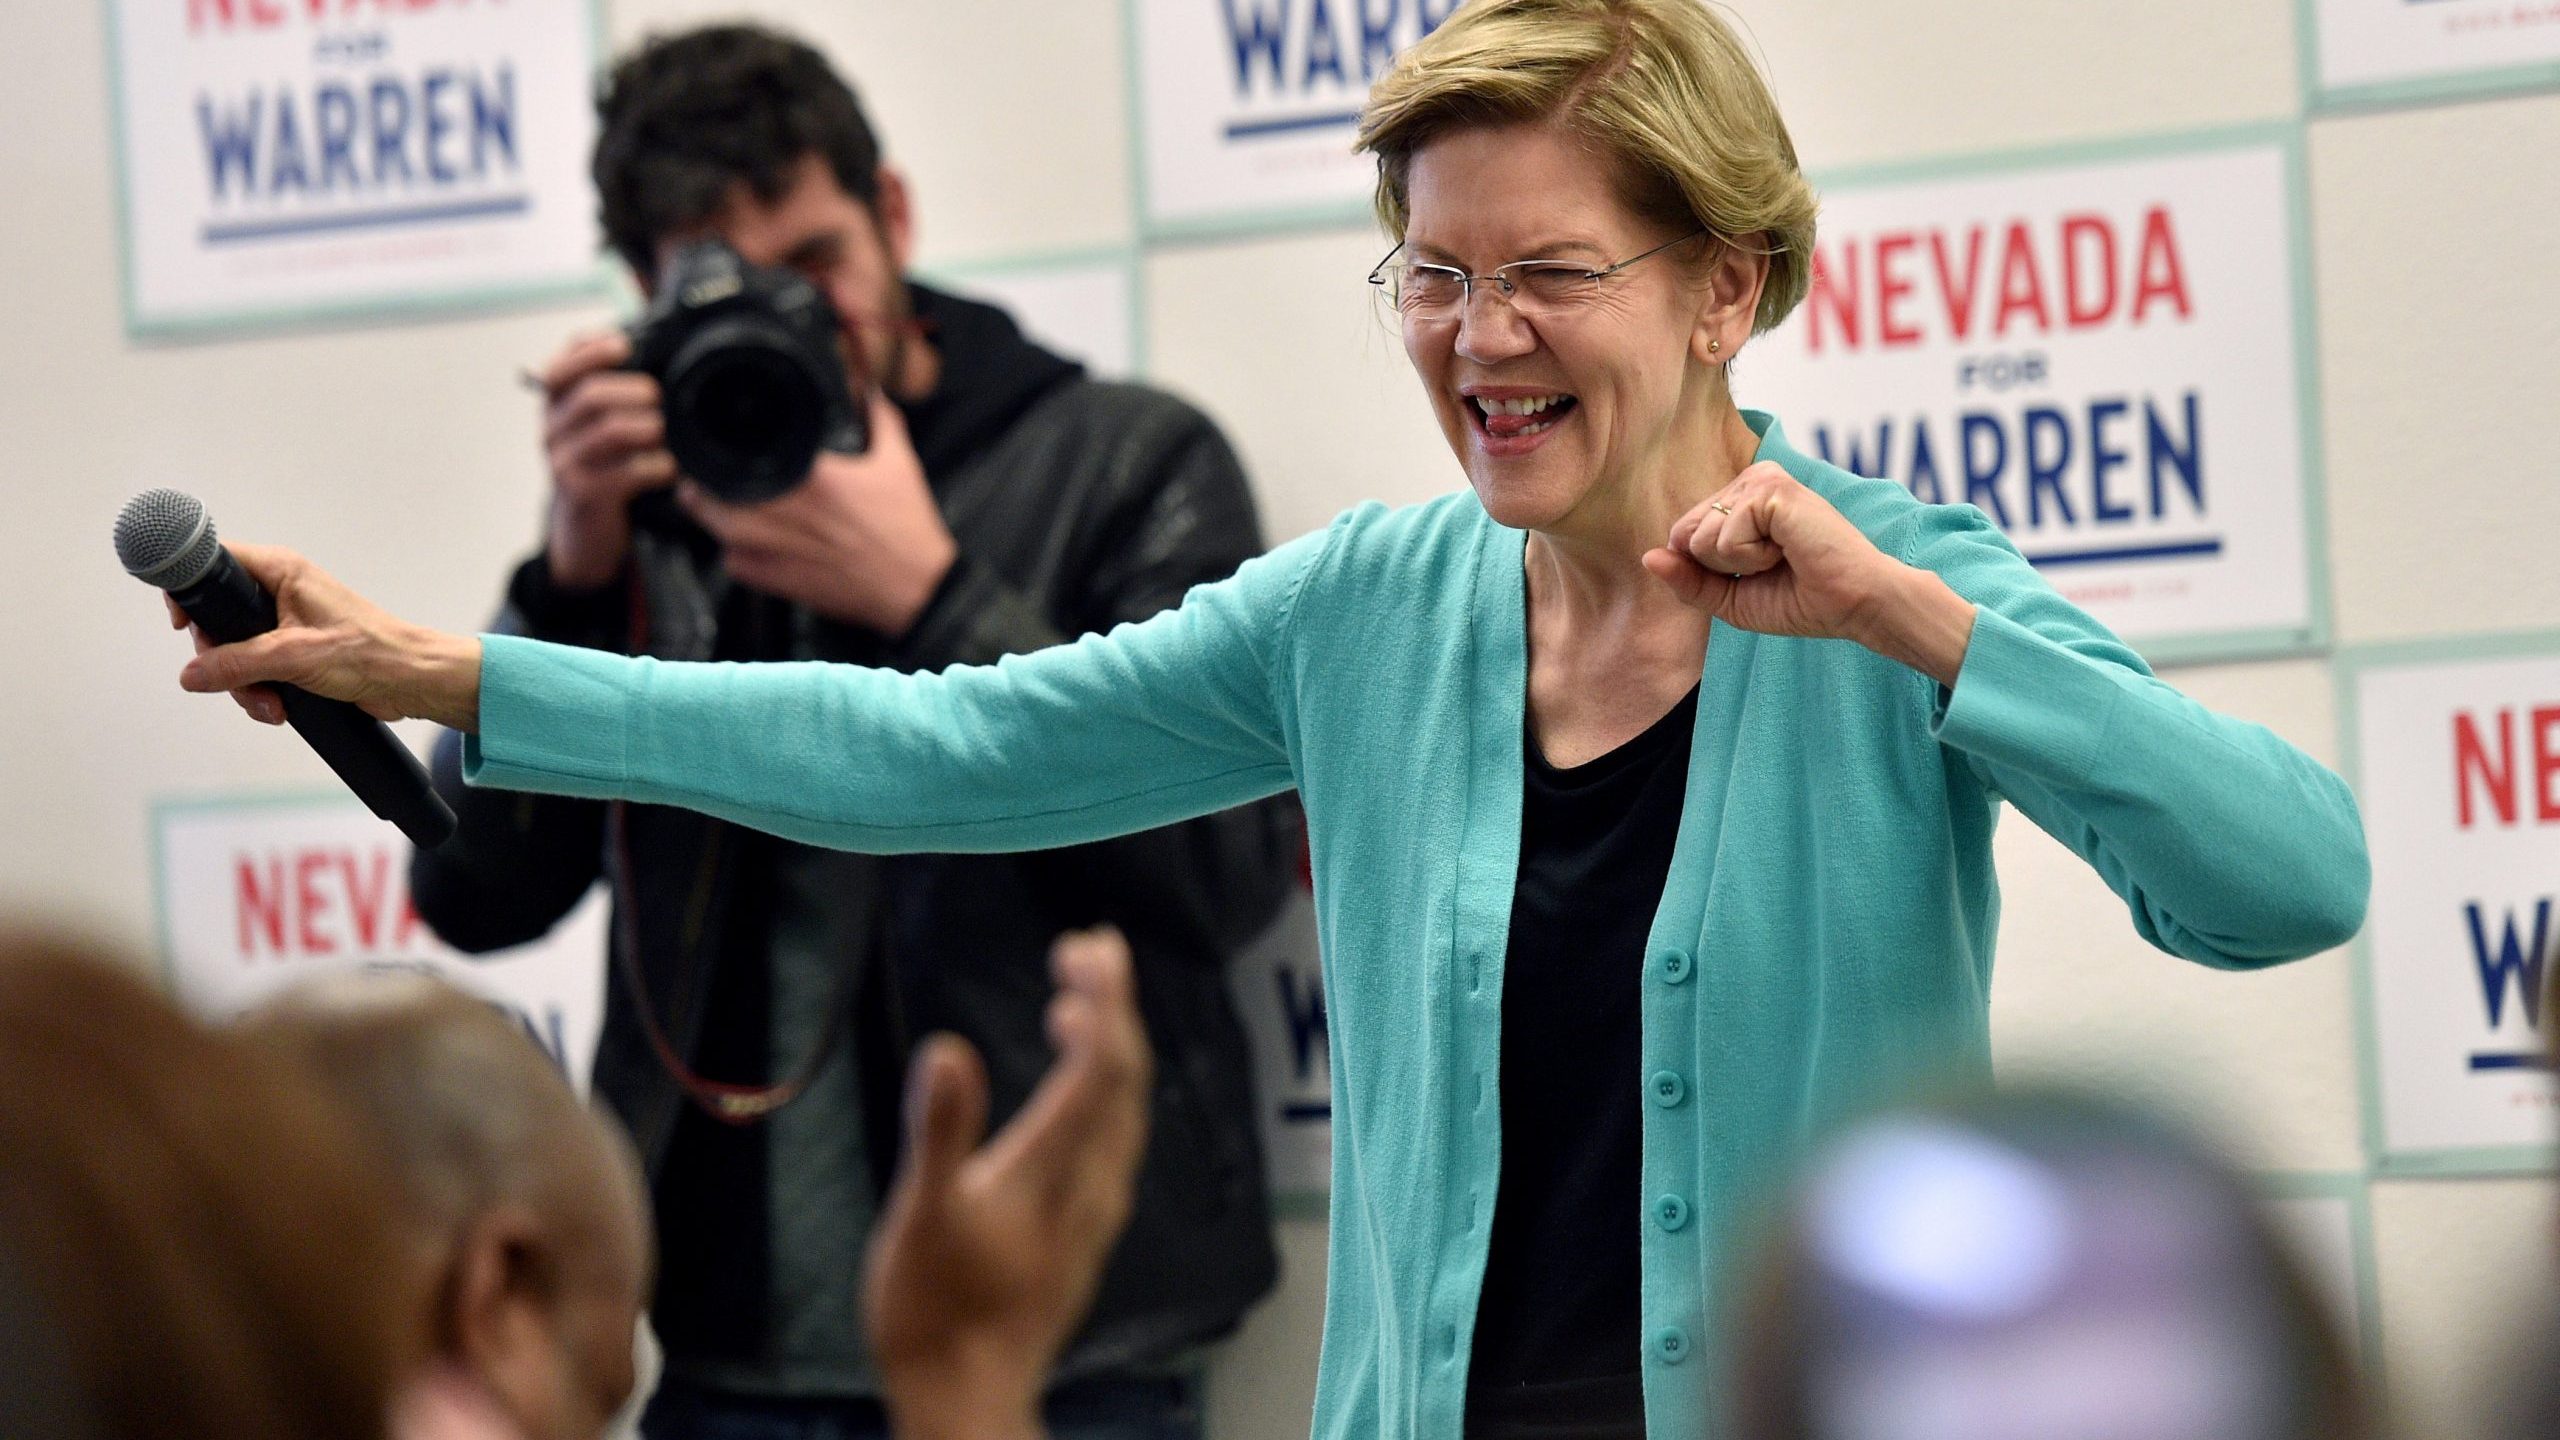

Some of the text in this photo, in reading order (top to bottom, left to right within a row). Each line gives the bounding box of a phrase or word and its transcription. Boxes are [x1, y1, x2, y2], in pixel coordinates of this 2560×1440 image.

[196, 64, 519, 197] WARREN
[1805, 204, 2195, 353] NEVADA
[1956, 352, 2050, 391] FOR
